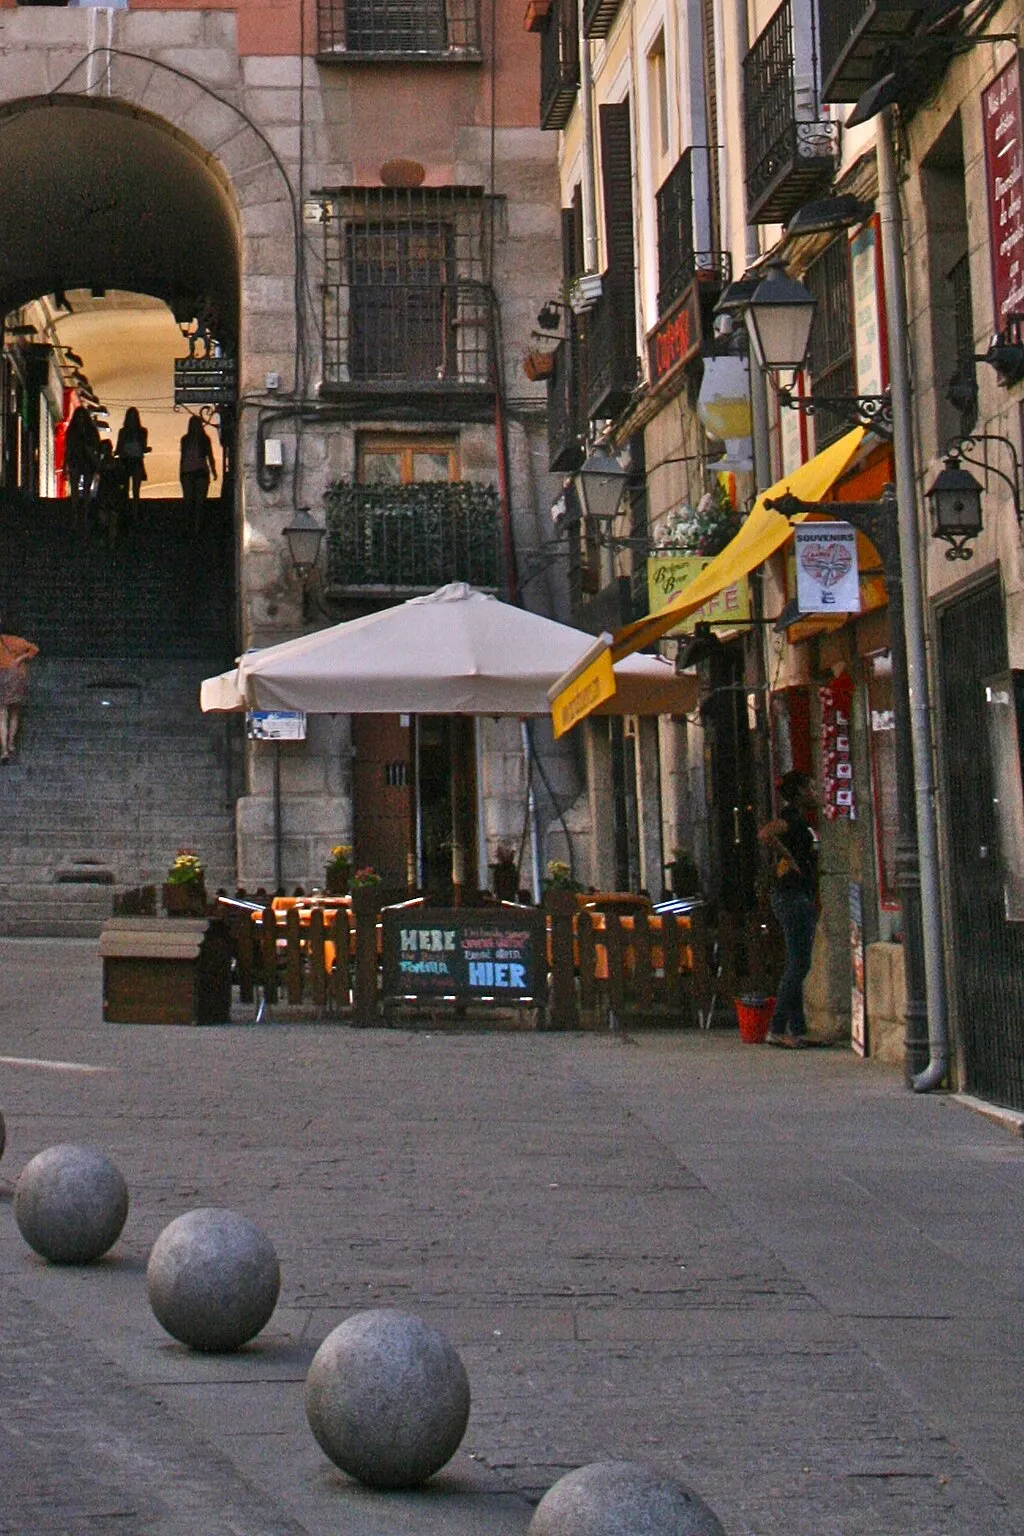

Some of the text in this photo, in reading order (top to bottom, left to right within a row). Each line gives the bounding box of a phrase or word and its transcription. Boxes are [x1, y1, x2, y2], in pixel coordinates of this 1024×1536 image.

[797, 534, 854, 543] SOUVENIRS
[400, 929, 456, 951] HERE
[468, 962, 527, 988] HIER
